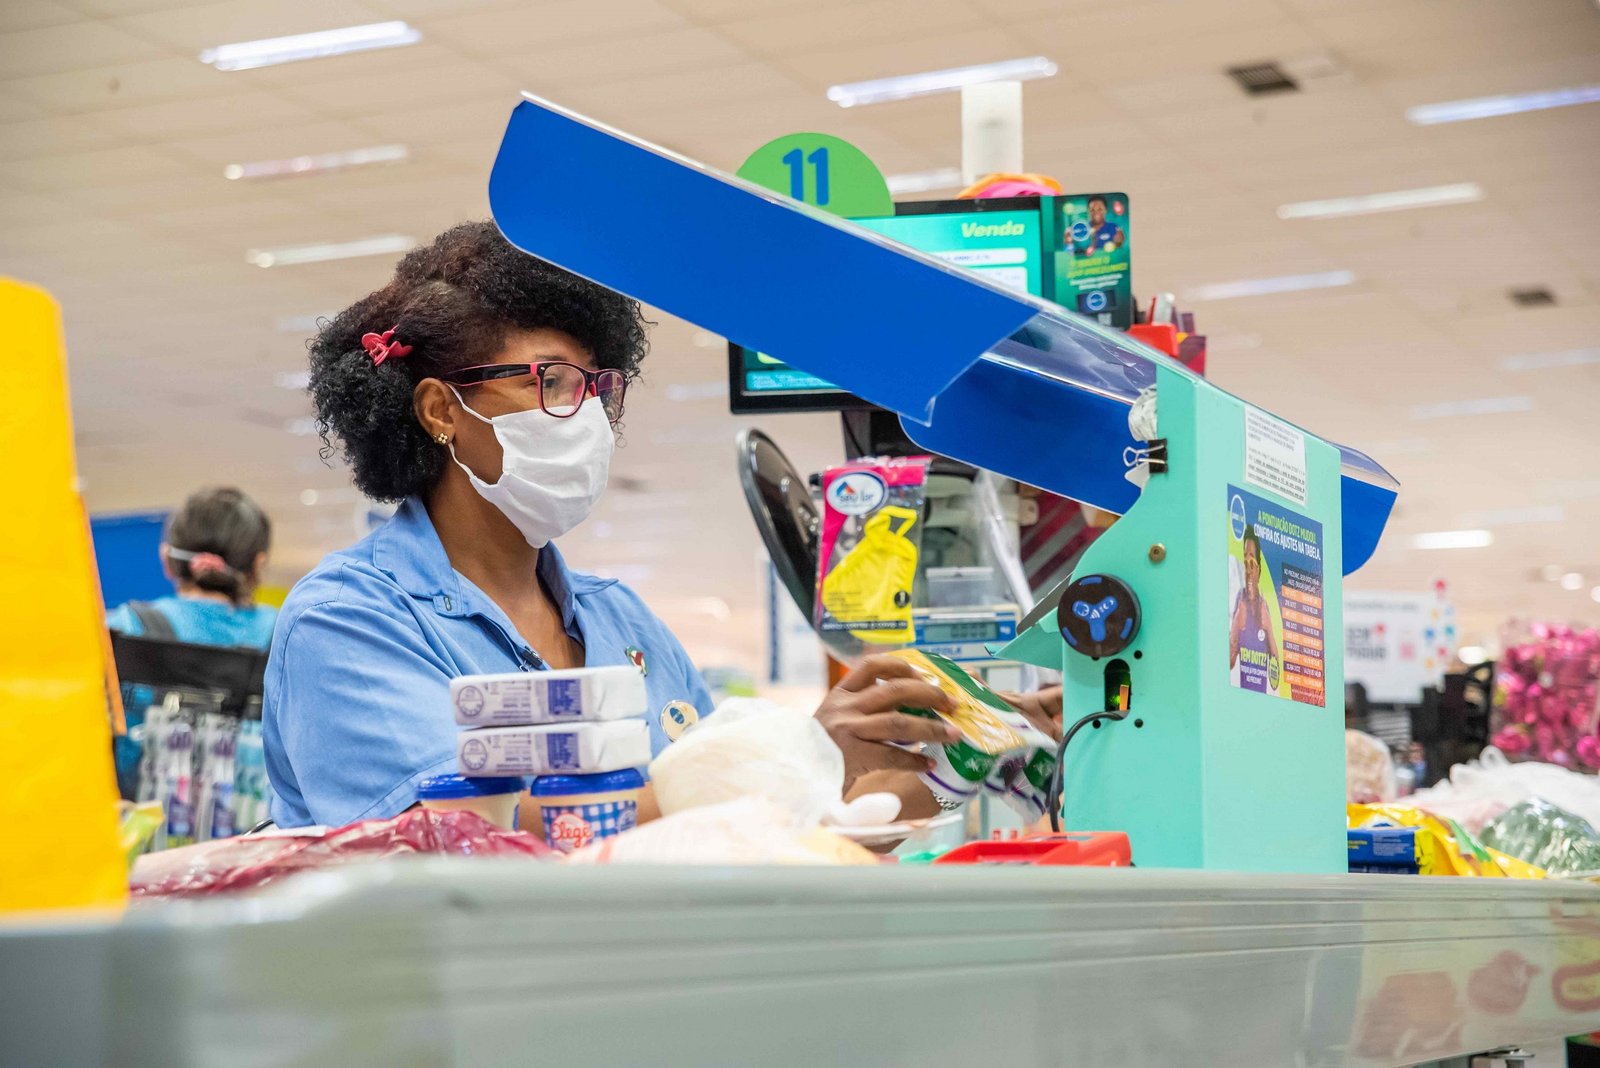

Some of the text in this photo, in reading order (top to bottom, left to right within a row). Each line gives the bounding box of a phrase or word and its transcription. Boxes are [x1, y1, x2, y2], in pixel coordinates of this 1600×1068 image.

[783, 147, 829, 206] 11
[961, 220, 1025, 238] Venda
[1253, 523, 1273, 543] CONFIRA
[1273, 531, 1280, 545] OS
[1280, 533, 1298, 552] AJUSTES
[1298, 540, 1304, 555] NA
